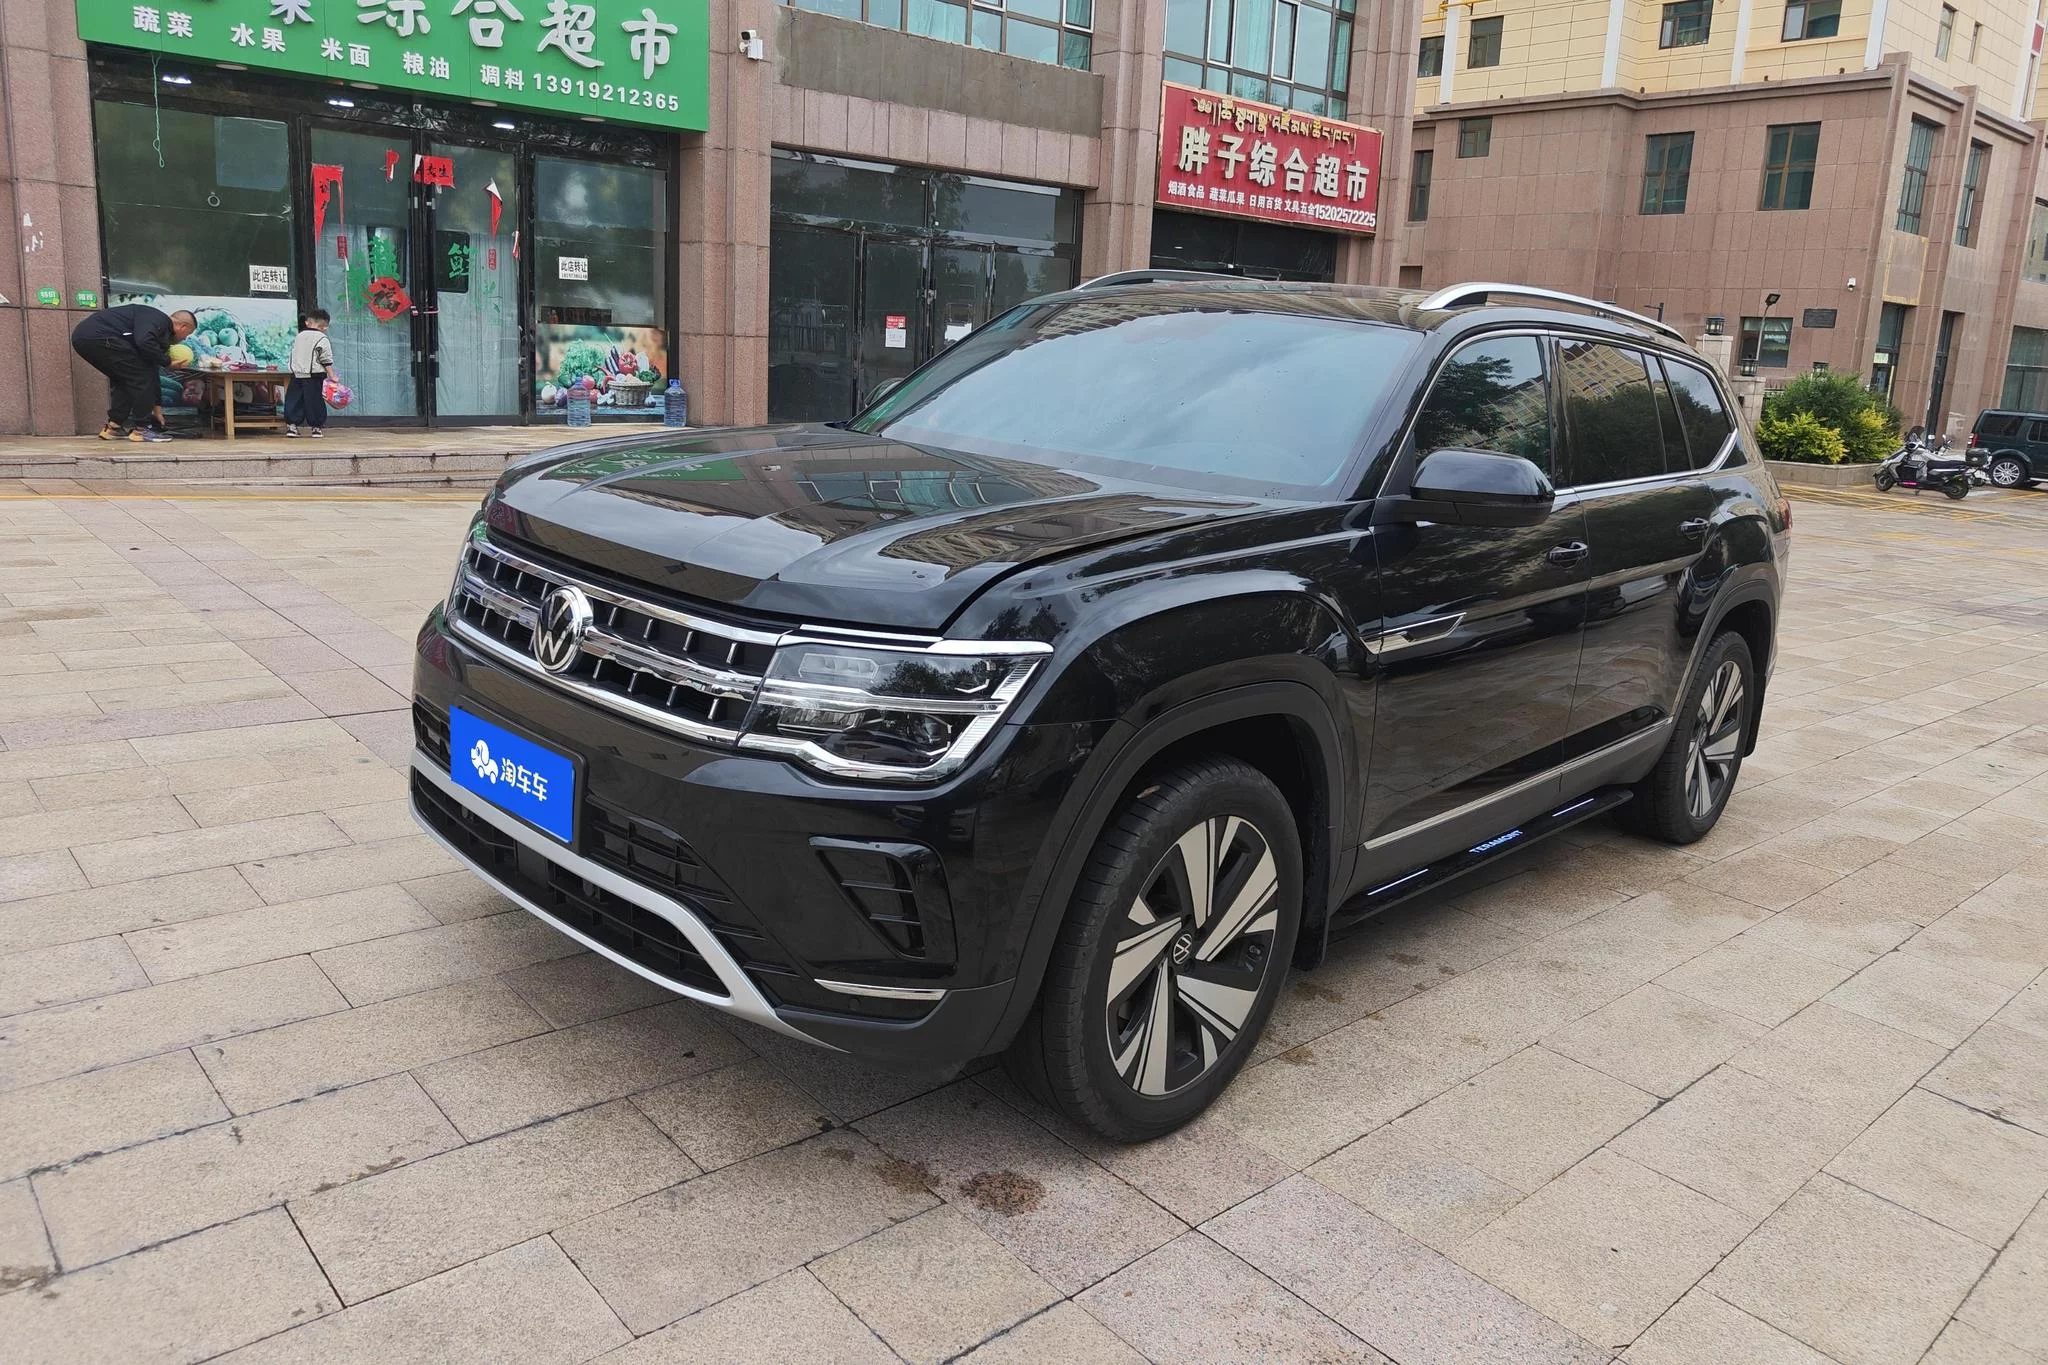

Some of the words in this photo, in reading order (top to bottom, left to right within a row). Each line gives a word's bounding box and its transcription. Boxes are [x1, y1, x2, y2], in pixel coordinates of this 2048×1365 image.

[133, 5, 193, 38] 蔬菜
[230, 22, 286, 53] 水果
[321, 37, 371, 68] 米面
[403, 51, 450, 80] 粮油
[480, 64, 525, 91] 调料
[533, 73, 679, 111] 13919212365
[1178, 125, 1370, 201] 胖子综合超市
[1168, 180, 1205, 199] 烟酒食品
[1209, 187, 1245, 205] 蔬菜瓜果
[1249, 194, 1283, 210] 日用百货
[1284, 199, 1316, 217] 文具五金
[1314, 203, 1376, 228] 15202572225
[252, 269, 287, 284] 此店转让
[561, 261, 588, 273] 此店转让
[1469, 829, 1523, 853] TERAMONT
